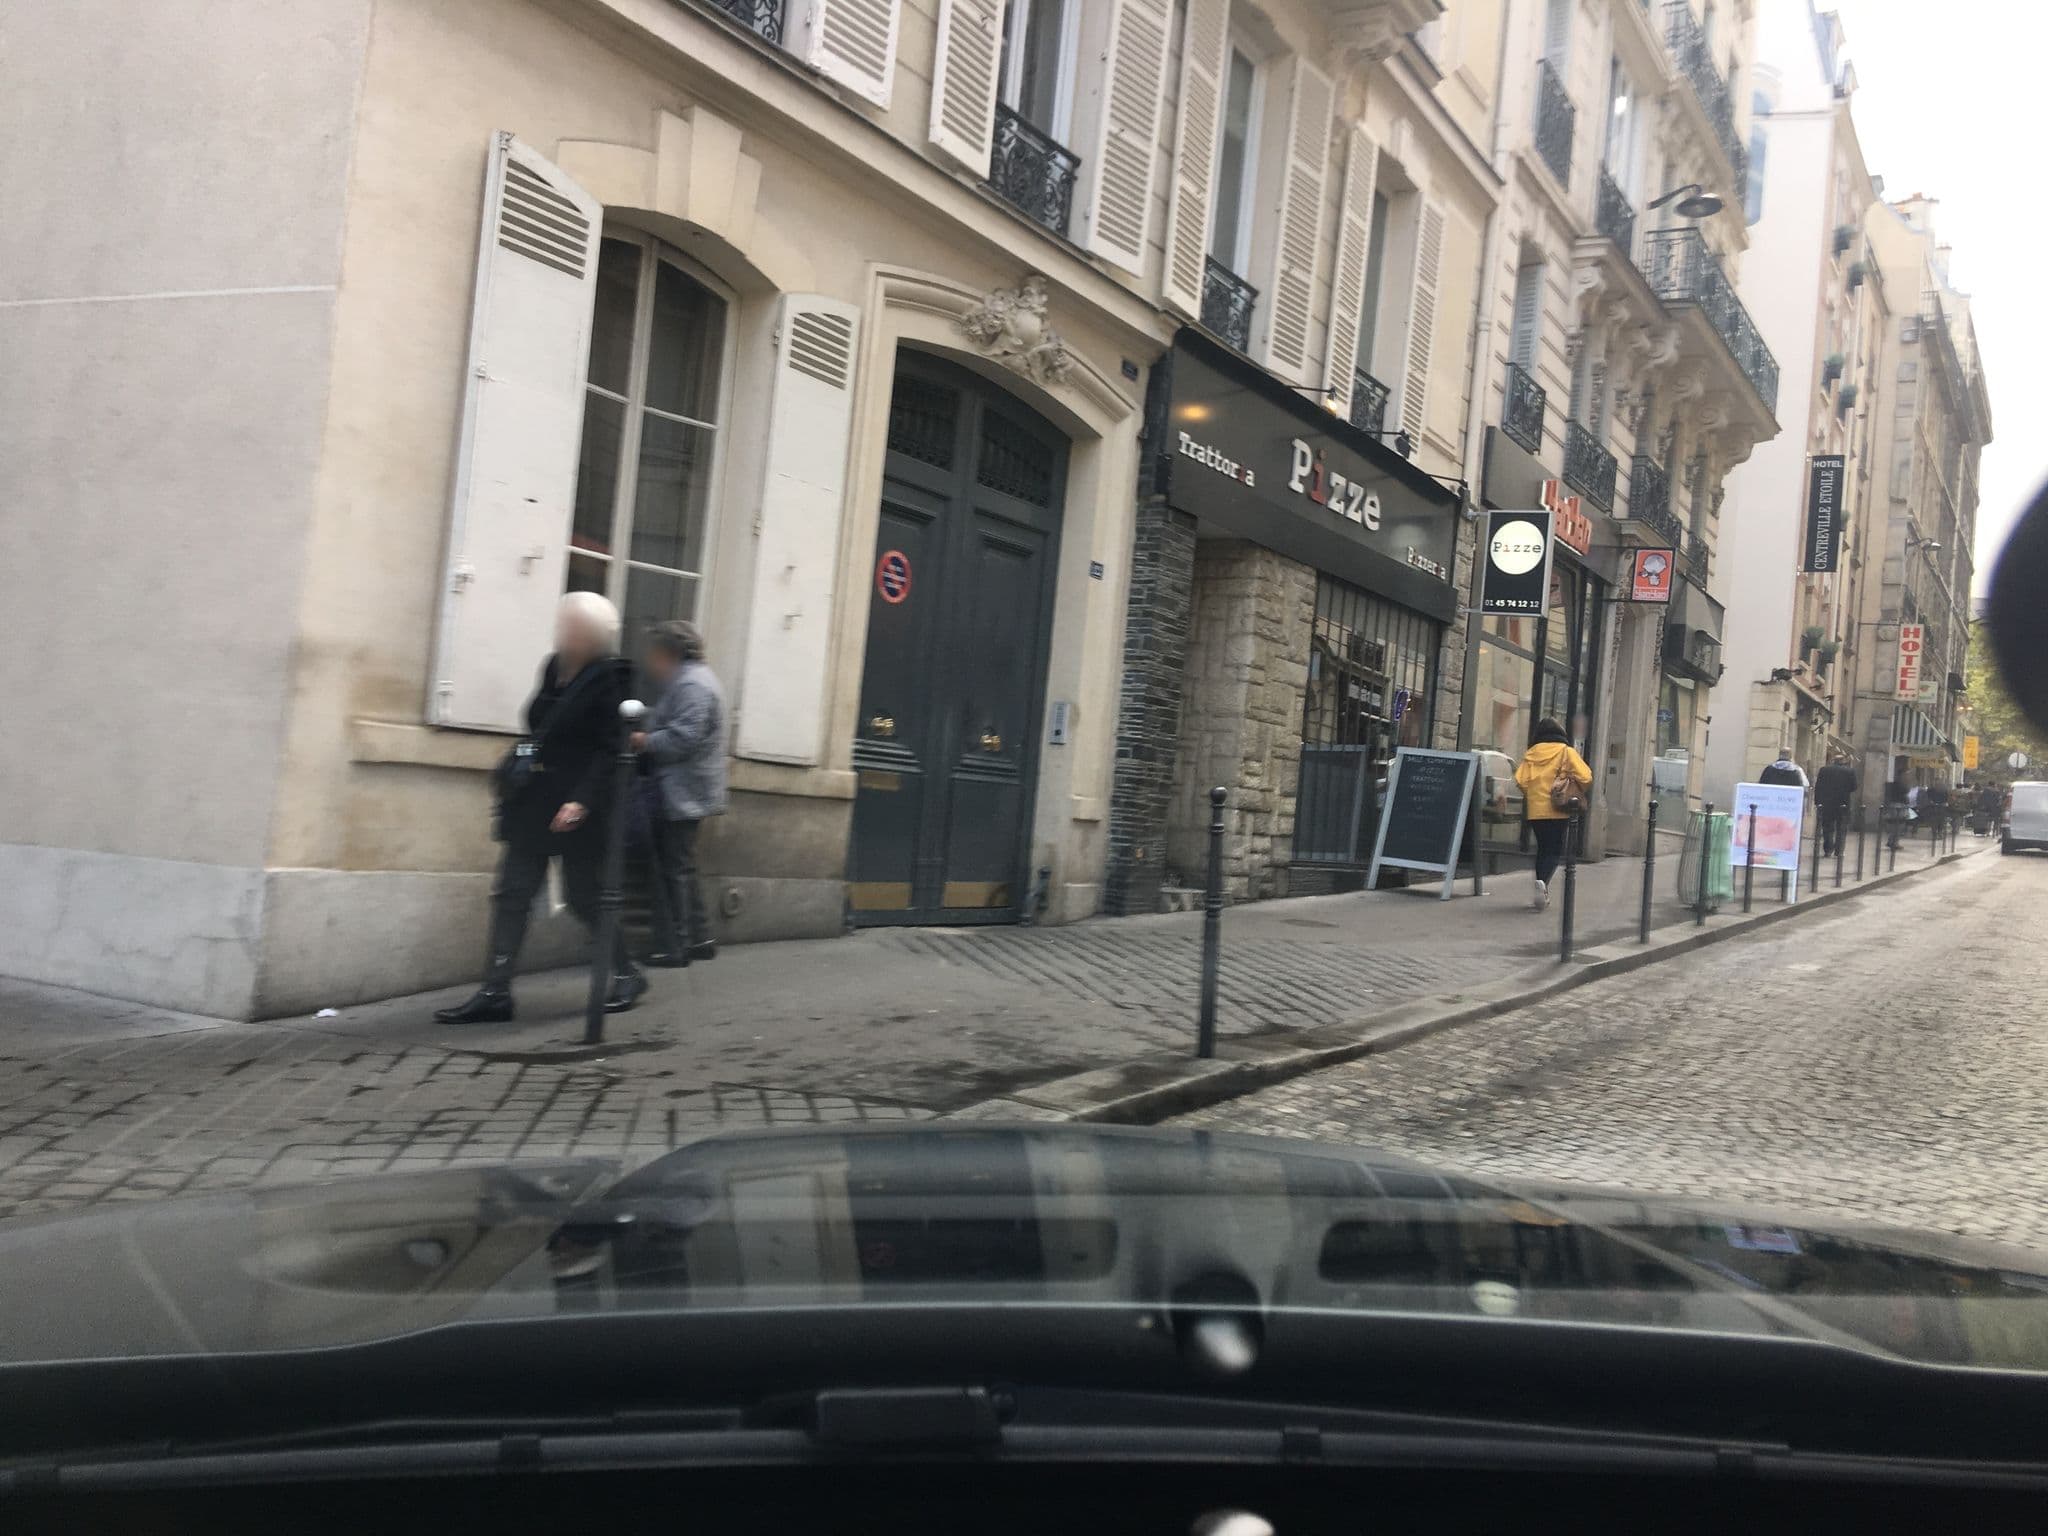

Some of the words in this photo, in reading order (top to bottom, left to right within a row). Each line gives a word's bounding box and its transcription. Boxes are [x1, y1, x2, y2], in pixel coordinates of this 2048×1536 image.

[1179, 431, 1255, 487] Trattoria
[1813, 460, 1843, 468] HOTEL
[1288, 438, 1381, 531] Pizze
[1819, 470, 1834, 504] ETOILE
[1493, 541, 1542, 553] Pizze
[1814, 506, 1832, 570] CENTREVILLE
[1408, 546, 1446, 580] Pizzeria
[1485, 599, 1494, 607] 01
[1495, 599, 1506, 607] 45
[1518, 600, 1528, 608] 12
[1899, 627, 1920, 690] HOTEL
